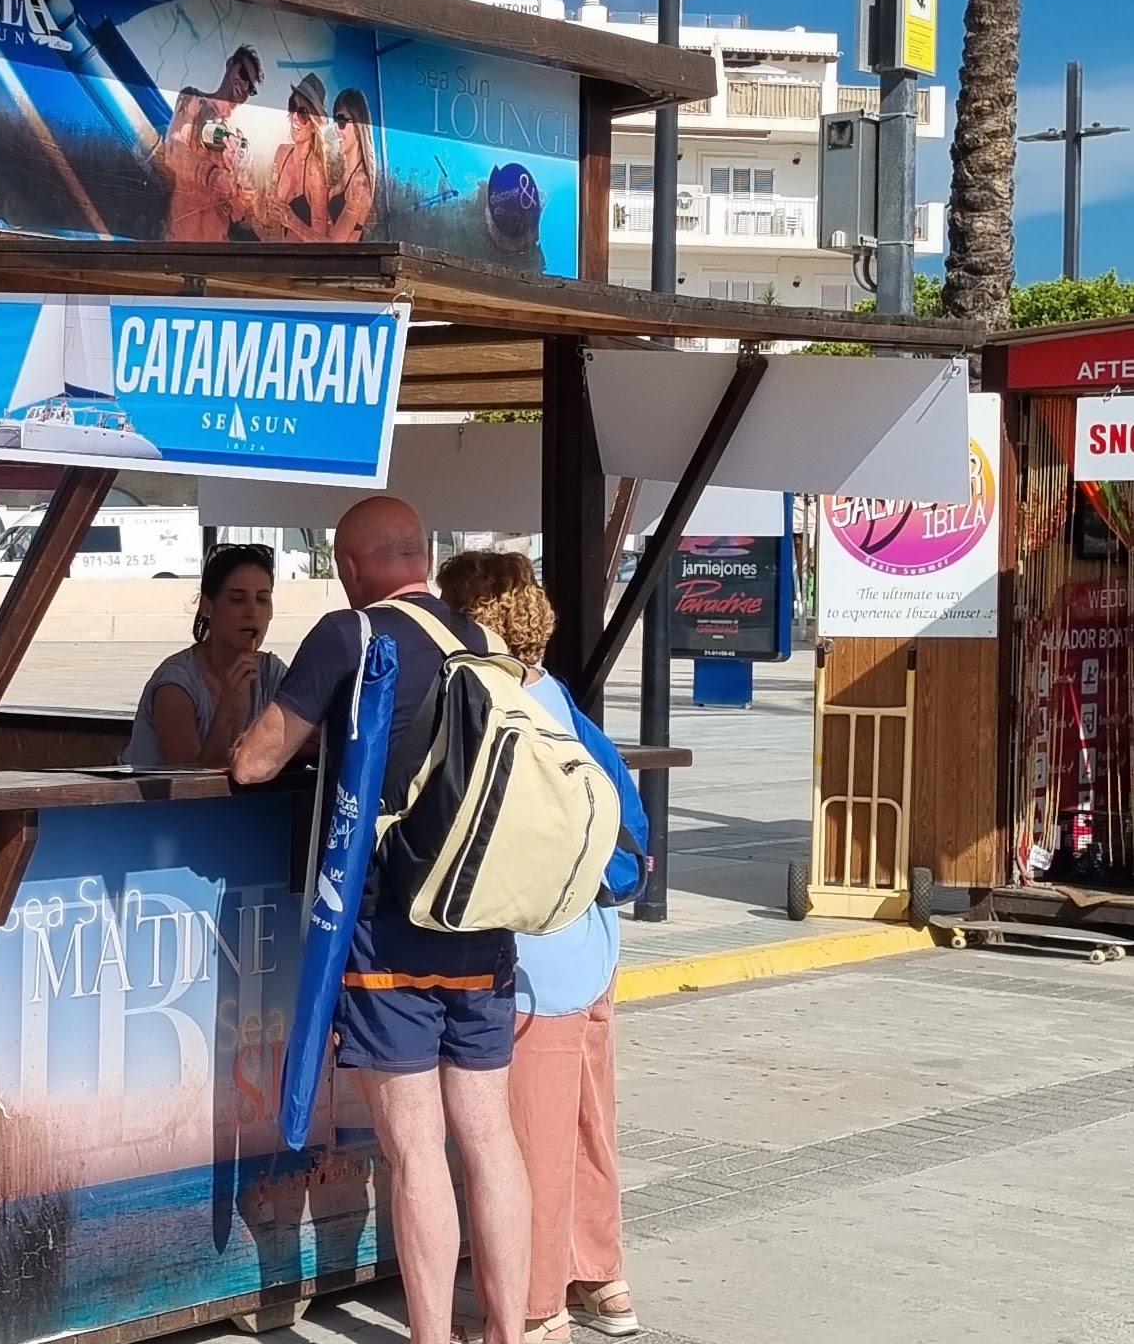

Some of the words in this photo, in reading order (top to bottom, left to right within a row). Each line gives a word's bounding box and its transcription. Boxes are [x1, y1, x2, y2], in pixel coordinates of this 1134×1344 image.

[416, 57, 449, 91] Sea
[456, 65, 490, 97] Sun
[432, 88, 578, 157] LOUNGE
[116, 316, 389, 405] CATAMARAN
[250, 416, 298, 434] SUN
[1089, 423, 1134, 455] SN
[921, 499, 987, 539] IBIZA
[82, 555, 121, 567] 971-34
[126, 555, 139, 566] 25
[143, 554, 156, 566] 25
[681, 559, 757, 578] jamiejones
[865, 556, 896, 574] Spain
[903, 559, 950, 575] Summer
[674, 579, 763, 613] Paradise
[856, 587, 878, 601] The
[882, 587, 933, 601] ultimate
[936, 590, 963, 605] way
[827, 607, 839, 619] to
[842, 609, 902, 623] experience
[905, 607, 938, 620] Ibiza
[939, 607, 981, 620] Sunset
[330, 866, 345, 879] UV
[77, 878, 143, 925] Sun
[218, 999, 285, 1052] Sea
